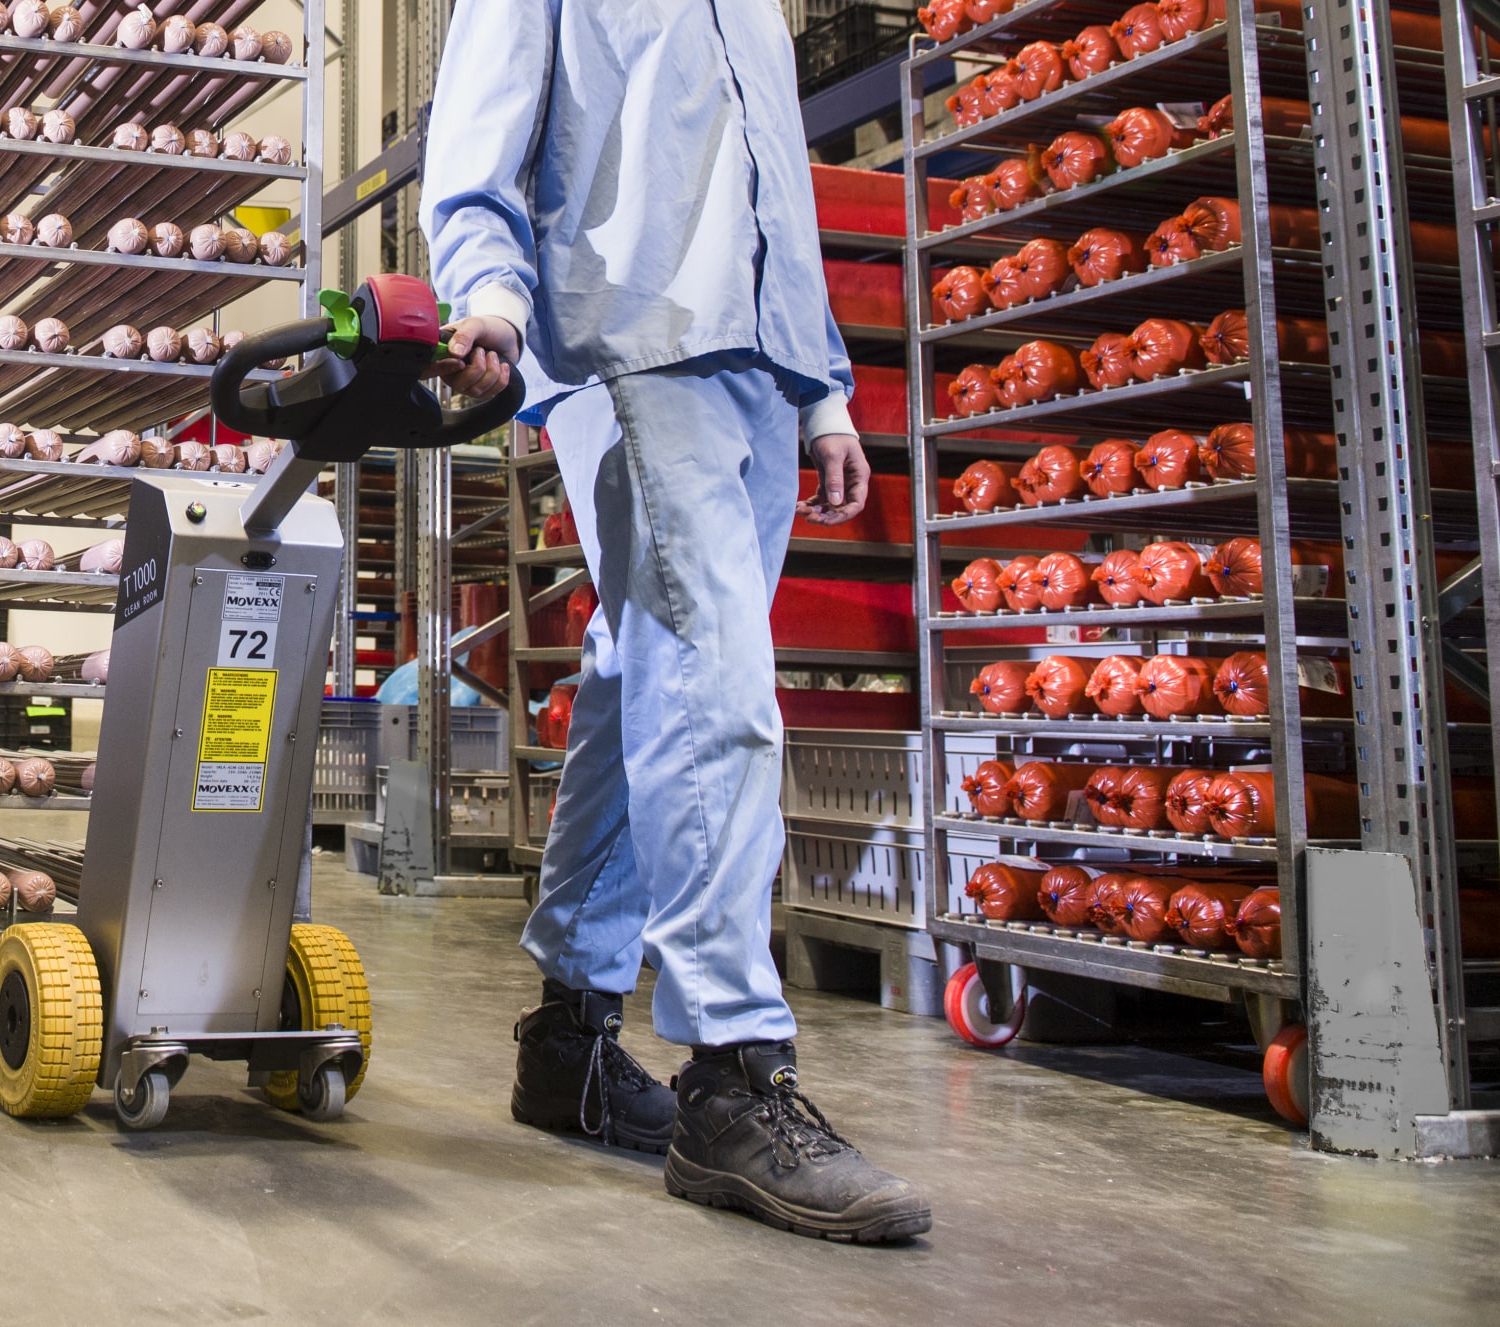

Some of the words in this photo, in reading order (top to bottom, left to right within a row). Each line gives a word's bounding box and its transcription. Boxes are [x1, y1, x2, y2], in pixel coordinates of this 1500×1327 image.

[124, 600, 141, 618] CLEAN
[143, 588, 158, 606] ROOM
[226, 595, 280, 607] MOVEXX
[229, 629, 268, 660] 72
[198, 784, 249, 793] MOVEXX
